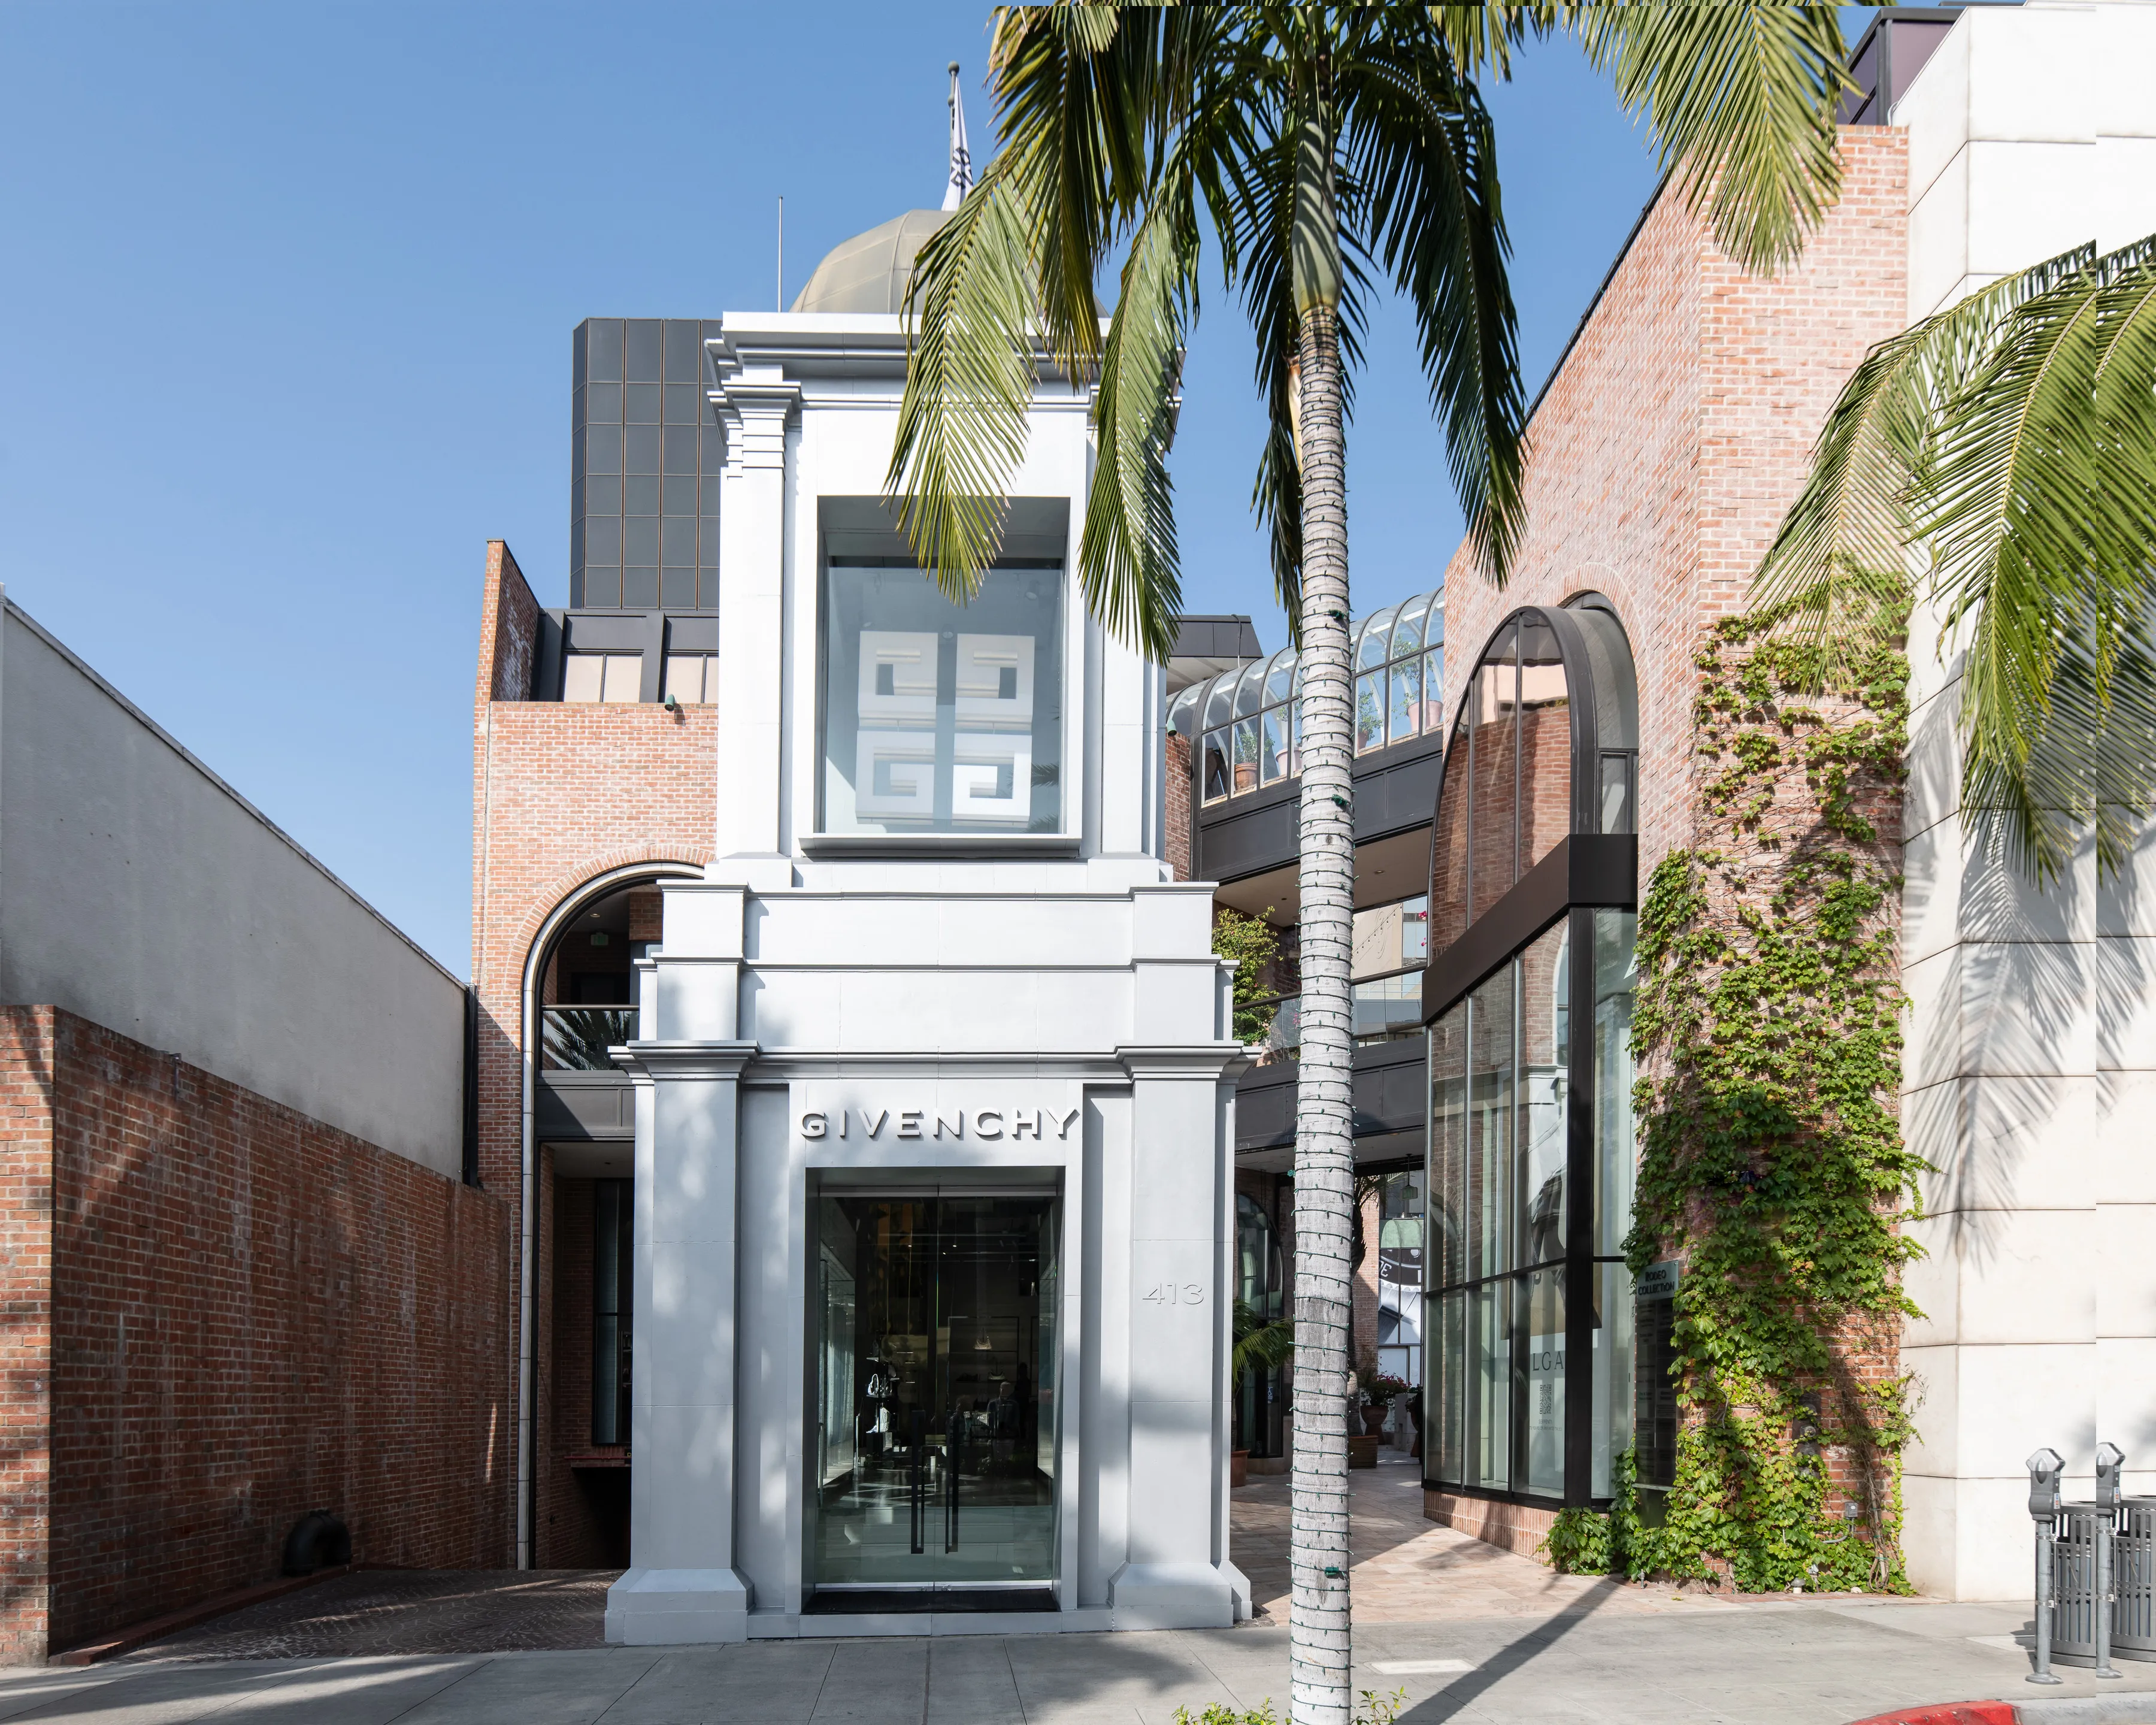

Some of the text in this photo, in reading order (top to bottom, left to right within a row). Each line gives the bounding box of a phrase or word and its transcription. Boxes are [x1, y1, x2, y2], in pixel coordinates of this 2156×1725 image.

[797, 1107, 1079, 1139] GIVENCHY
[1645, 1270, 1666, 1282] RODEO
[1142, 1282, 1204, 1305] 413
[1638, 1281, 1674, 1295] COLLECTION
